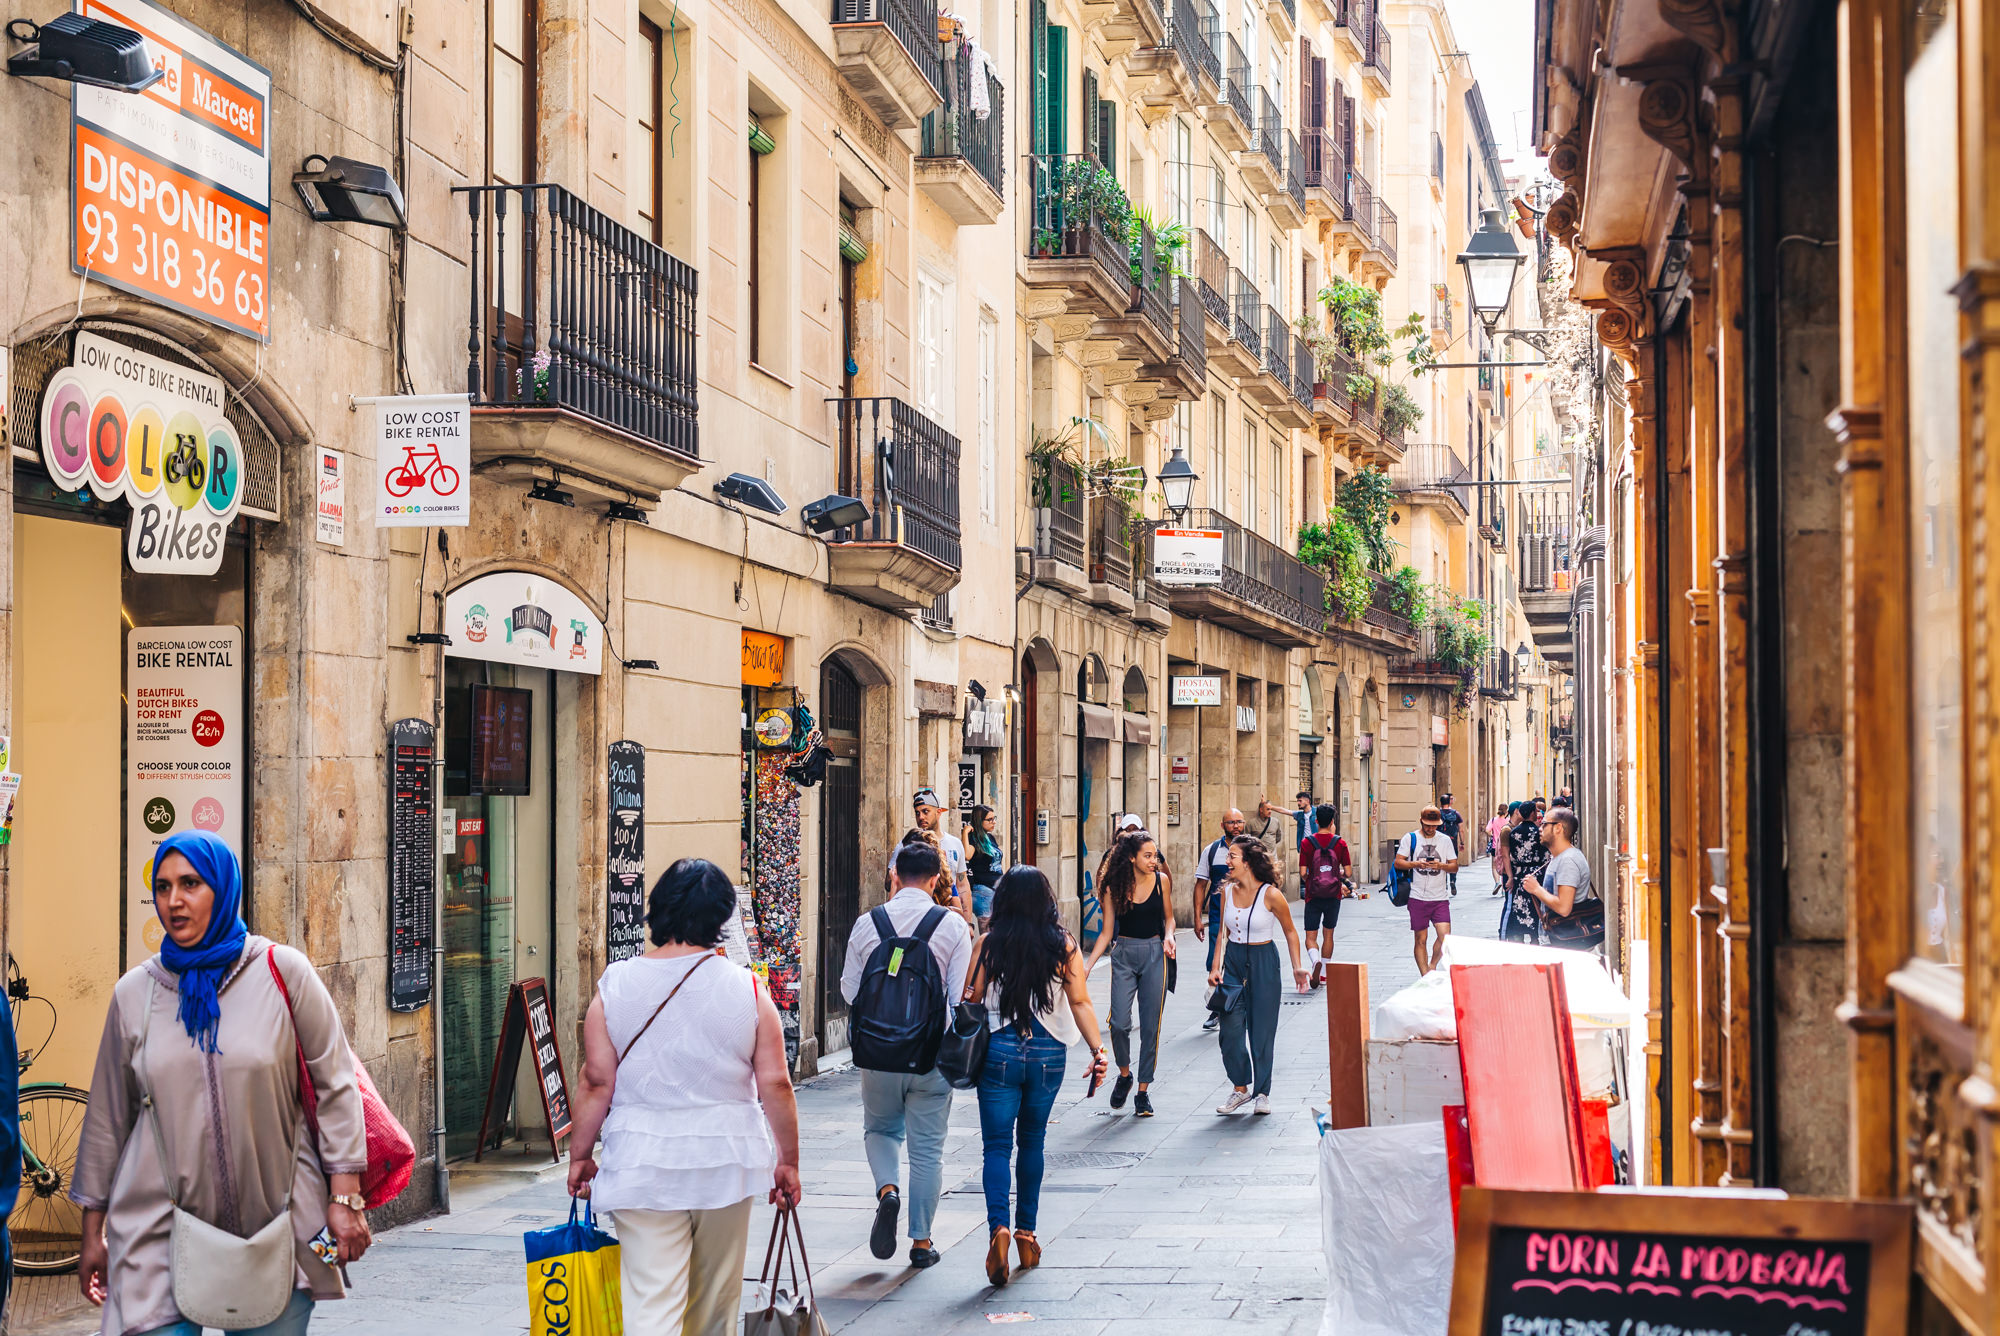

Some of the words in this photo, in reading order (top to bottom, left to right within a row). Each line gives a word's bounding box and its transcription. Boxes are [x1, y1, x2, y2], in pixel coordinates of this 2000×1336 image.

[192, 72, 255, 136] Marcet
[98, 91, 167, 137] PATRIMONIO
[173, 130, 178, 142] &
[184, 136, 254, 180] INVERSIONES
[84, 142, 263, 265] DISPONIBLE
[82, 204, 118, 264] 93
[132, 224, 181, 288] 318
[192, 249, 224, 306] 36
[234, 269, 264, 321] 63
[81, 344, 110, 371] LOW
[114, 356, 146, 383] COST
[148, 368, 174, 393] BIKE
[178, 376, 218, 408] RENTAL
[386, 412, 418, 425] LOW
[422, 412, 460, 424] COST
[386, 428, 412, 438] BIKE
[417, 426, 460, 438] RENTAL
[319, 501, 342, 518] ALARMA
[136, 503, 222, 561] Bikes
[137, 641, 186, 650] BARCELONA
[188, 641, 206, 649] LOW
[209, 640, 232, 649] COST
[137, 653, 170, 668] BIKE
[176, 652, 232, 667] RENTAL
[137, 688, 184, 697] BEAUTIFUL
[137, 699, 169, 708] DUTCH
[172, 699, 198, 708] BIKES
[137, 710, 156, 719] FOR
[159, 710, 182, 719] RENT
[196, 722, 220, 738] 2€/h
[461, 821, 472, 834] JUST
[472, 821, 482, 831] EAT
[611, 891, 630, 904] menu
[632, 886, 642, 905] del
[530, 1002, 551, 1041] CORTE
[1526, 1233, 1620, 1276] FORN
[1631, 1241, 1670, 1278] LA
[1680, 1246, 1852, 1296] MODERNA
